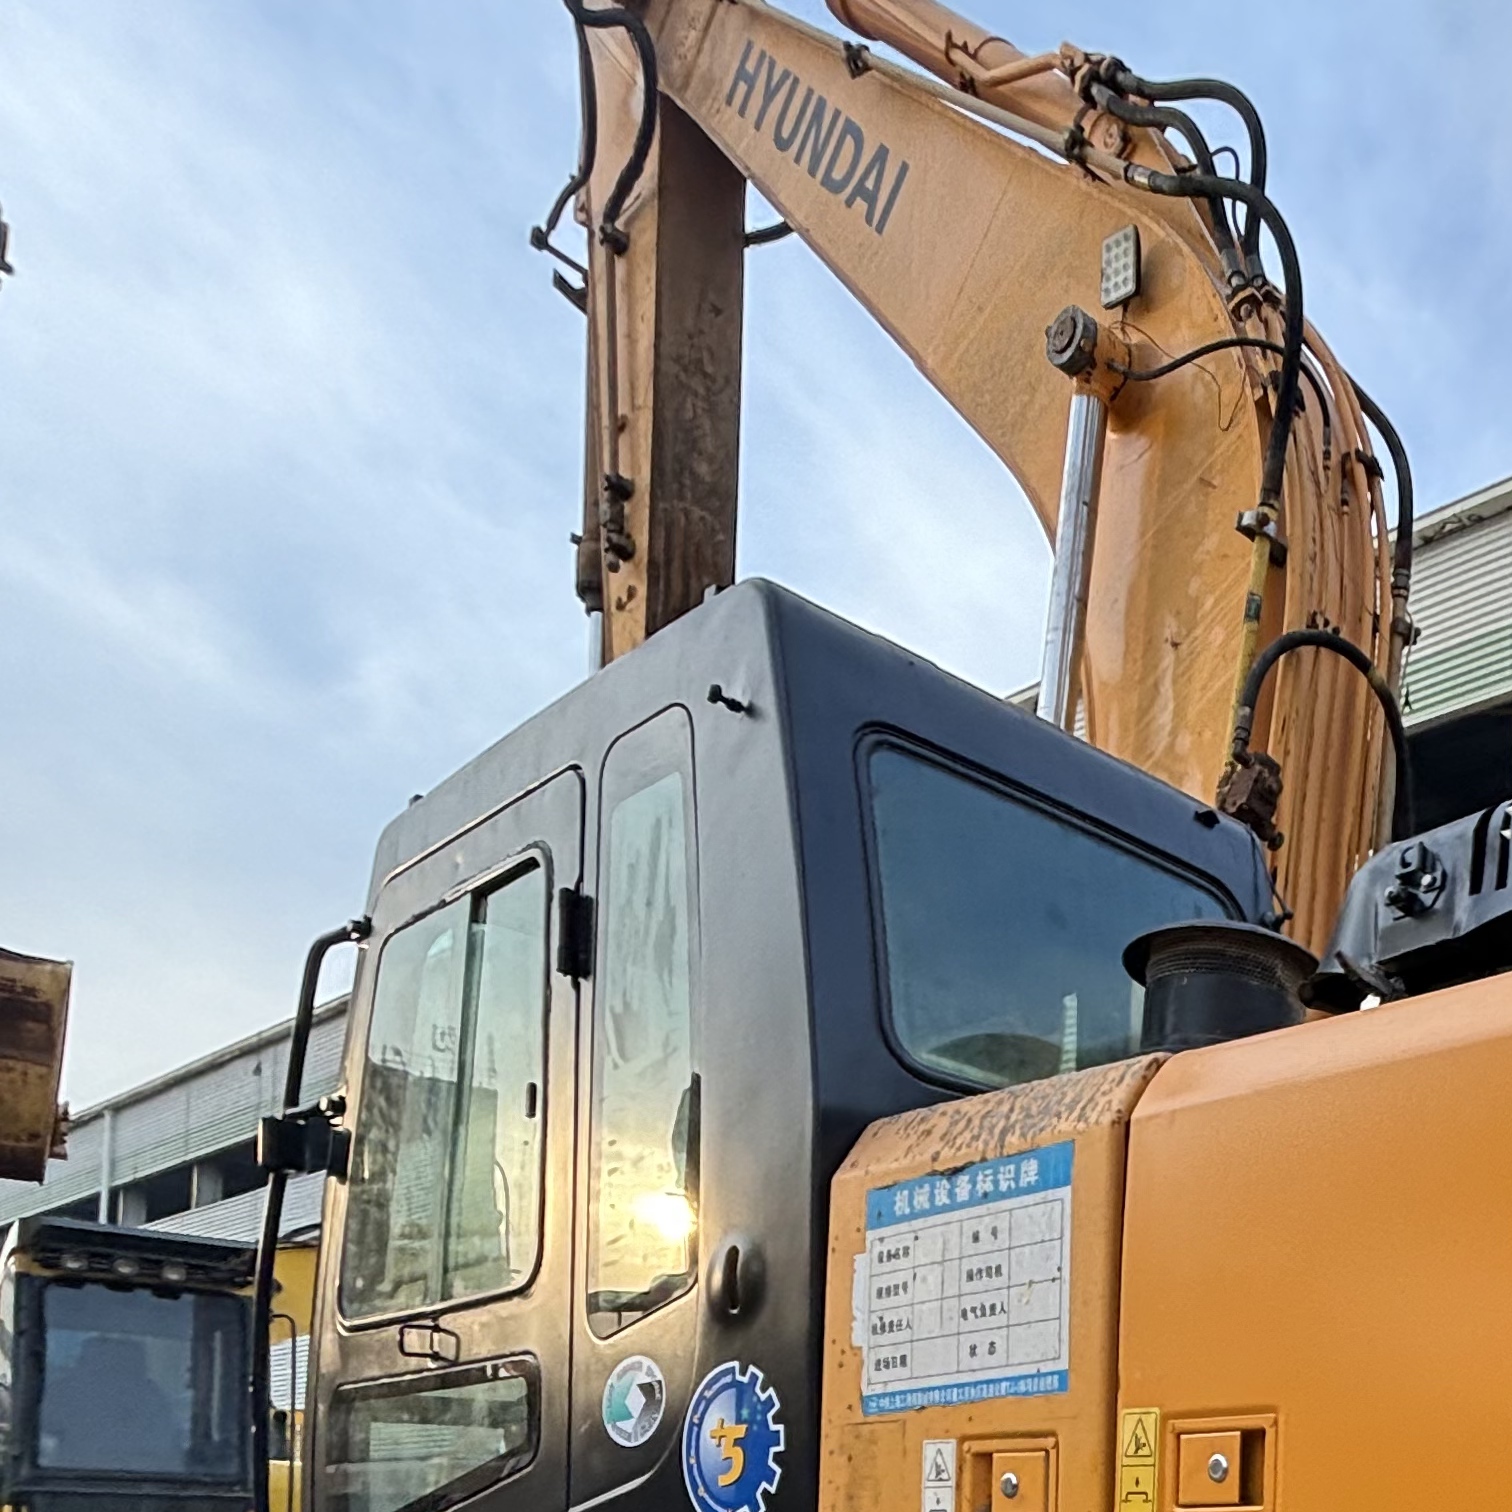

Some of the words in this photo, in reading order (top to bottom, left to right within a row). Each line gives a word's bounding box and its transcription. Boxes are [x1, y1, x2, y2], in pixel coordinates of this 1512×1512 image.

[725, 40, 910, 236] HYUNDAI
[893, 1158, 1040, 1217] 机械设备标识牌
